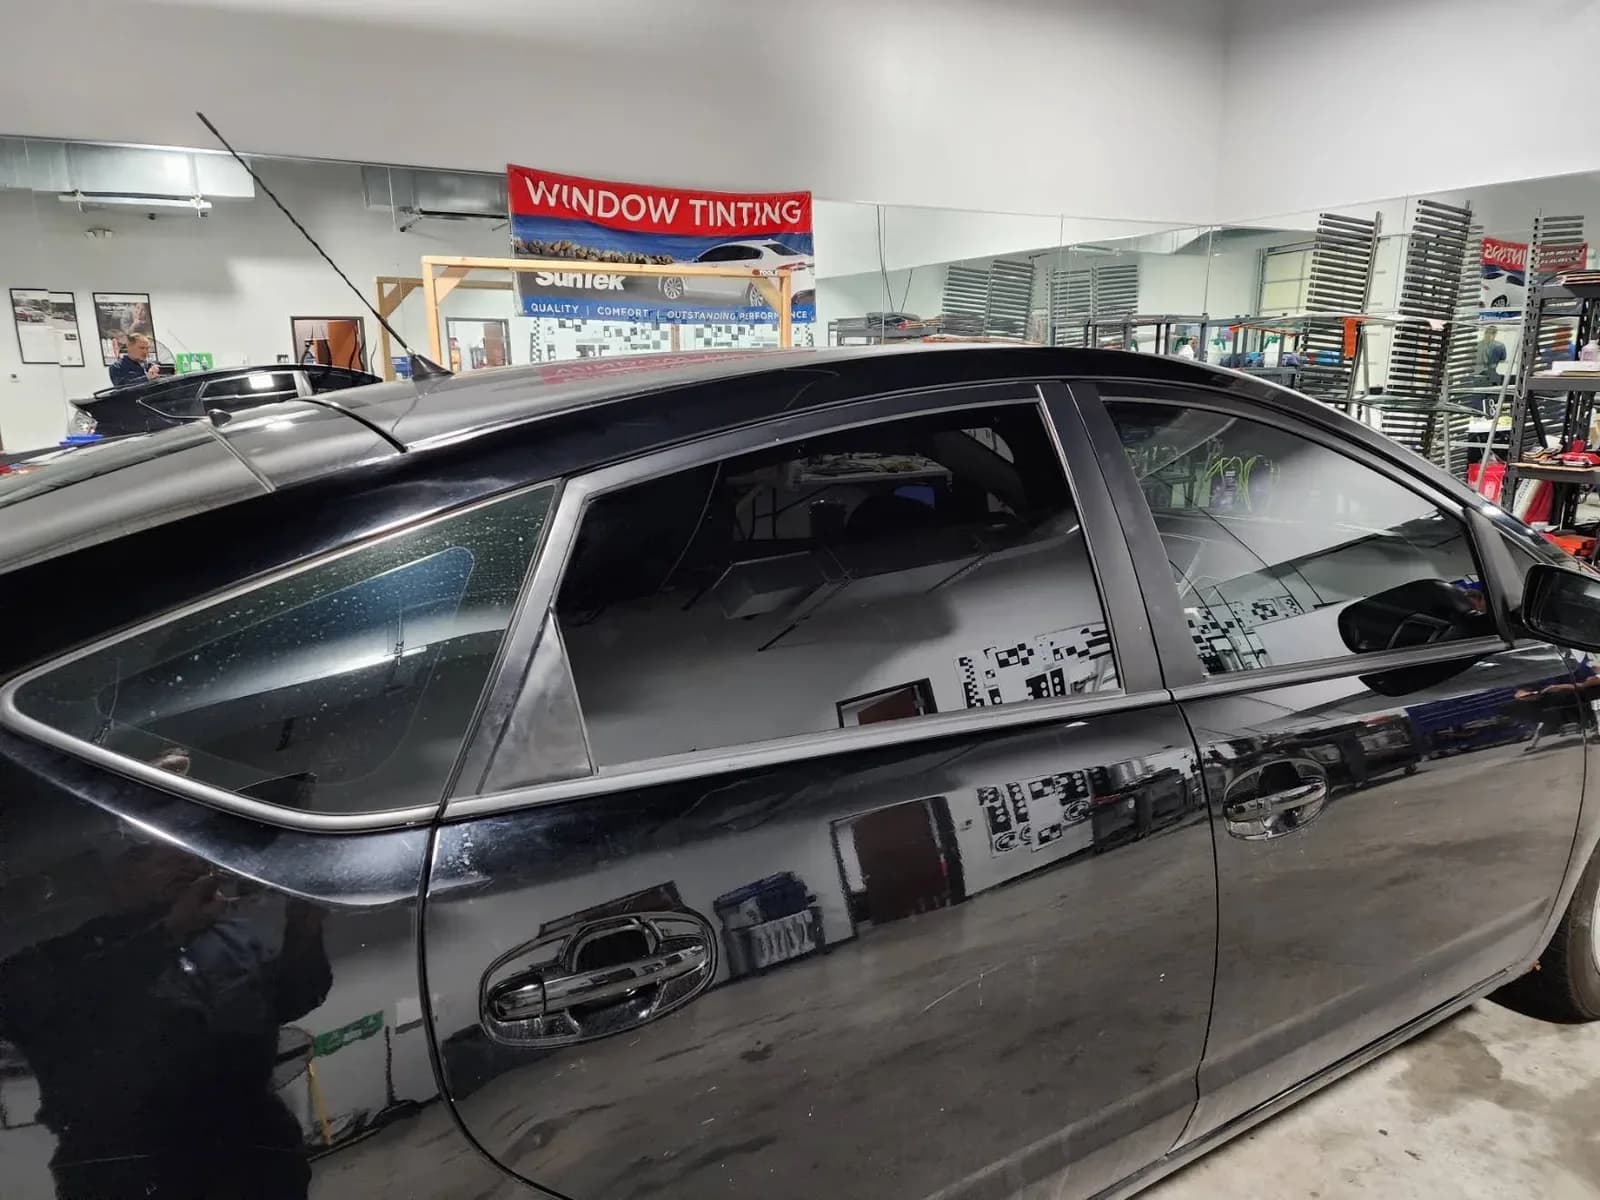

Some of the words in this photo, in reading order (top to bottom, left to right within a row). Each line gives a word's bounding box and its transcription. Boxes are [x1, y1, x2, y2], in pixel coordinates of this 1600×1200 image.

[525, 176, 679, 224] WINDOW
[689, 199, 802, 227] TINTING
[530, 303, 579, 313] QUALITY
[597, 306, 649, 317] COMFORT
[667, 310, 736, 320] OUTSTANDING
[739, 310, 808, 320] PERFORNCE
